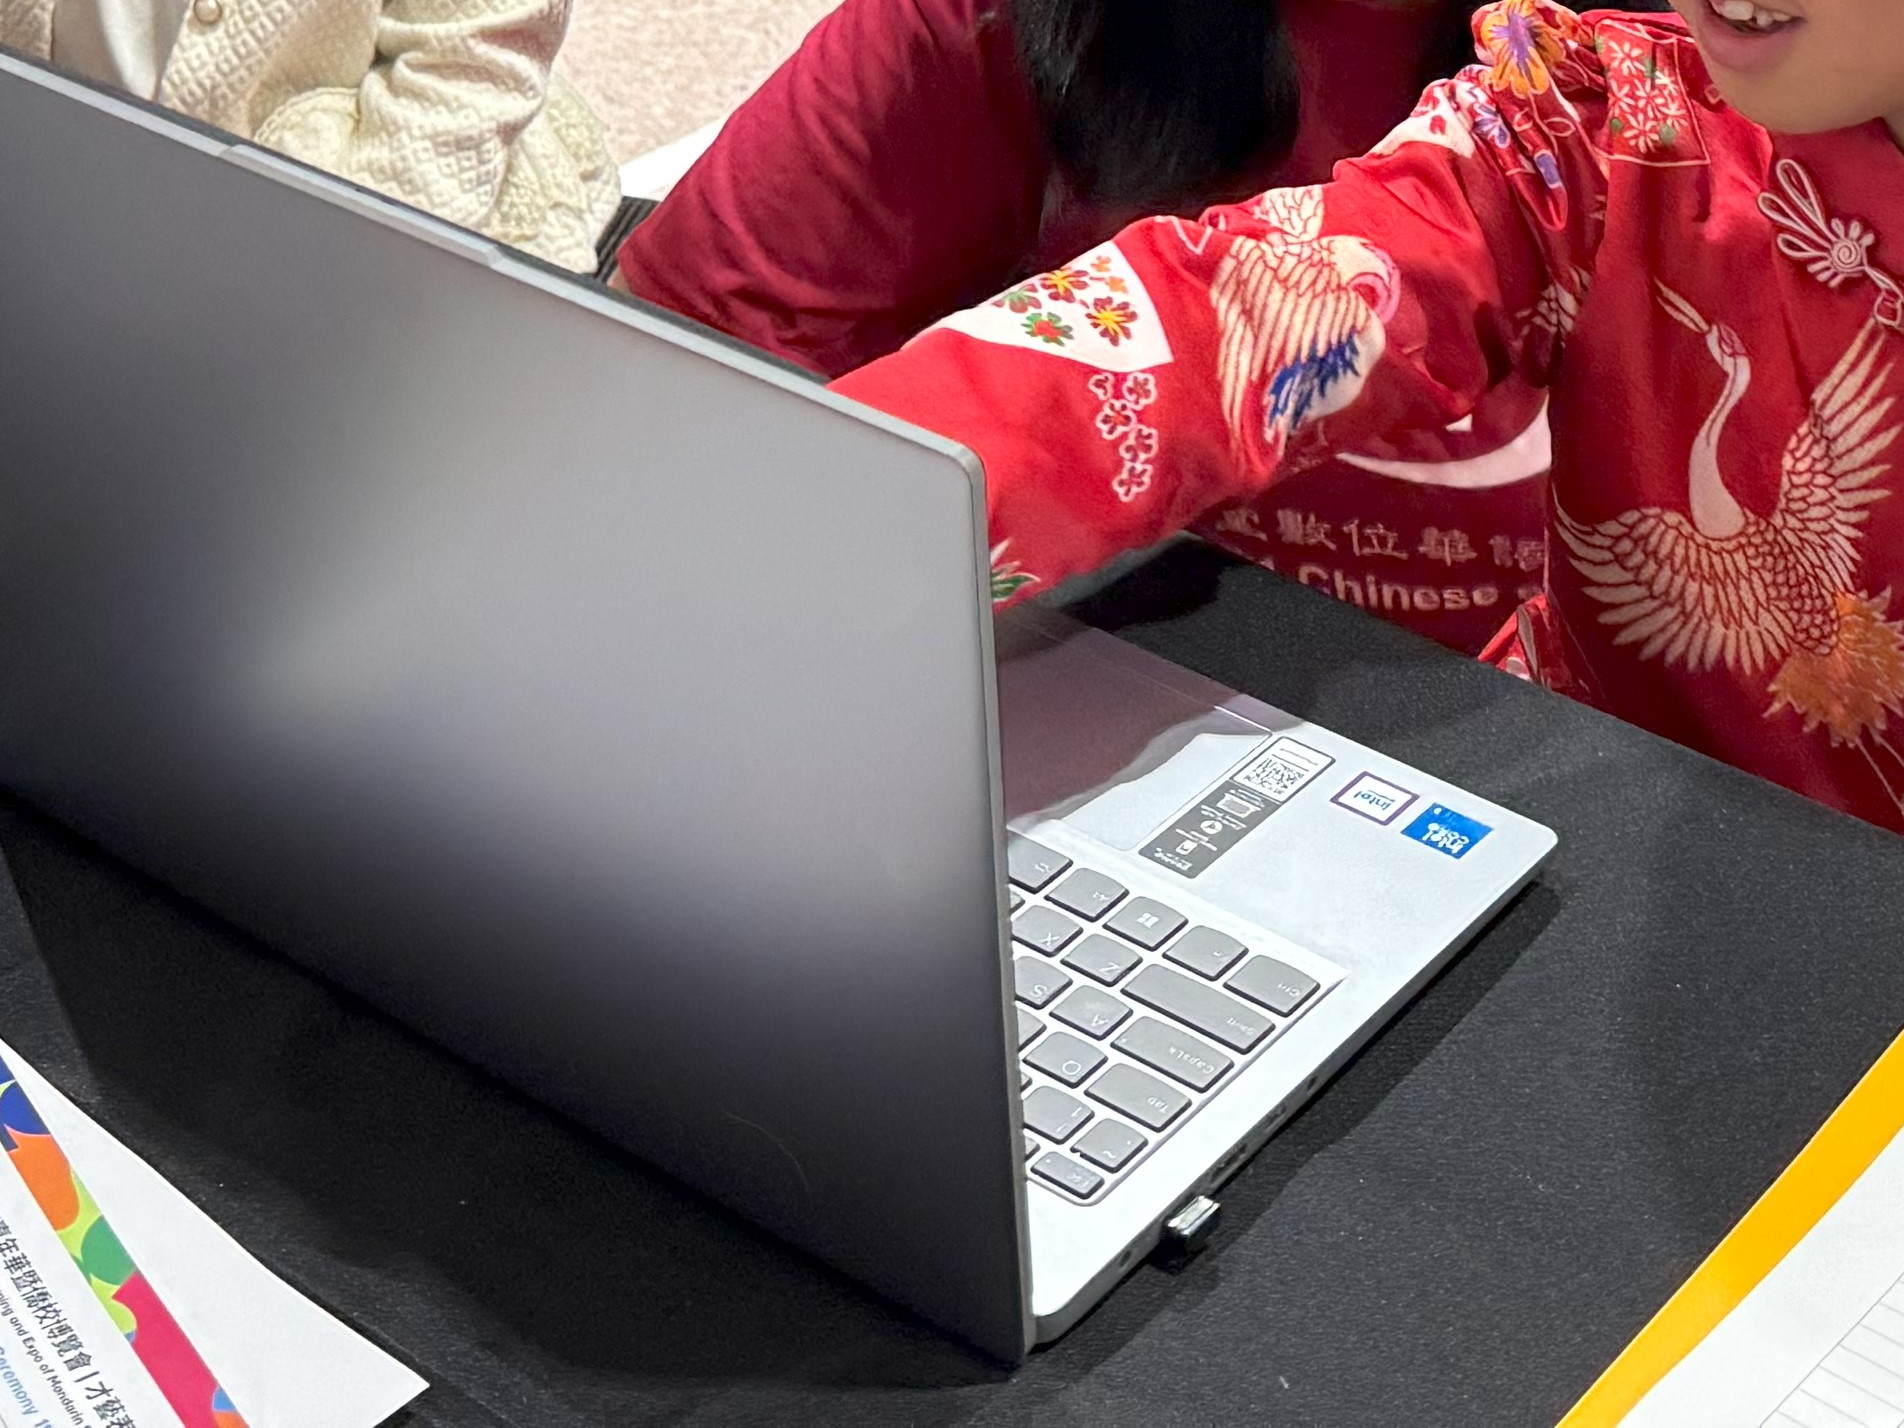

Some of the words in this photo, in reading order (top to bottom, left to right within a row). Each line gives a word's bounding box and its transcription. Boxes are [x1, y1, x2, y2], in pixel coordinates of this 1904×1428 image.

[1299, 564, 1498, 612] Chinese
[1353, 789, 1396, 812] intel
[8, 1313, 26, 1336] and
[21, 1331, 45, 1364] Expo
[40, 1361, 52, 1378] of
[48, 1374, 86, 1428] Mandarin
